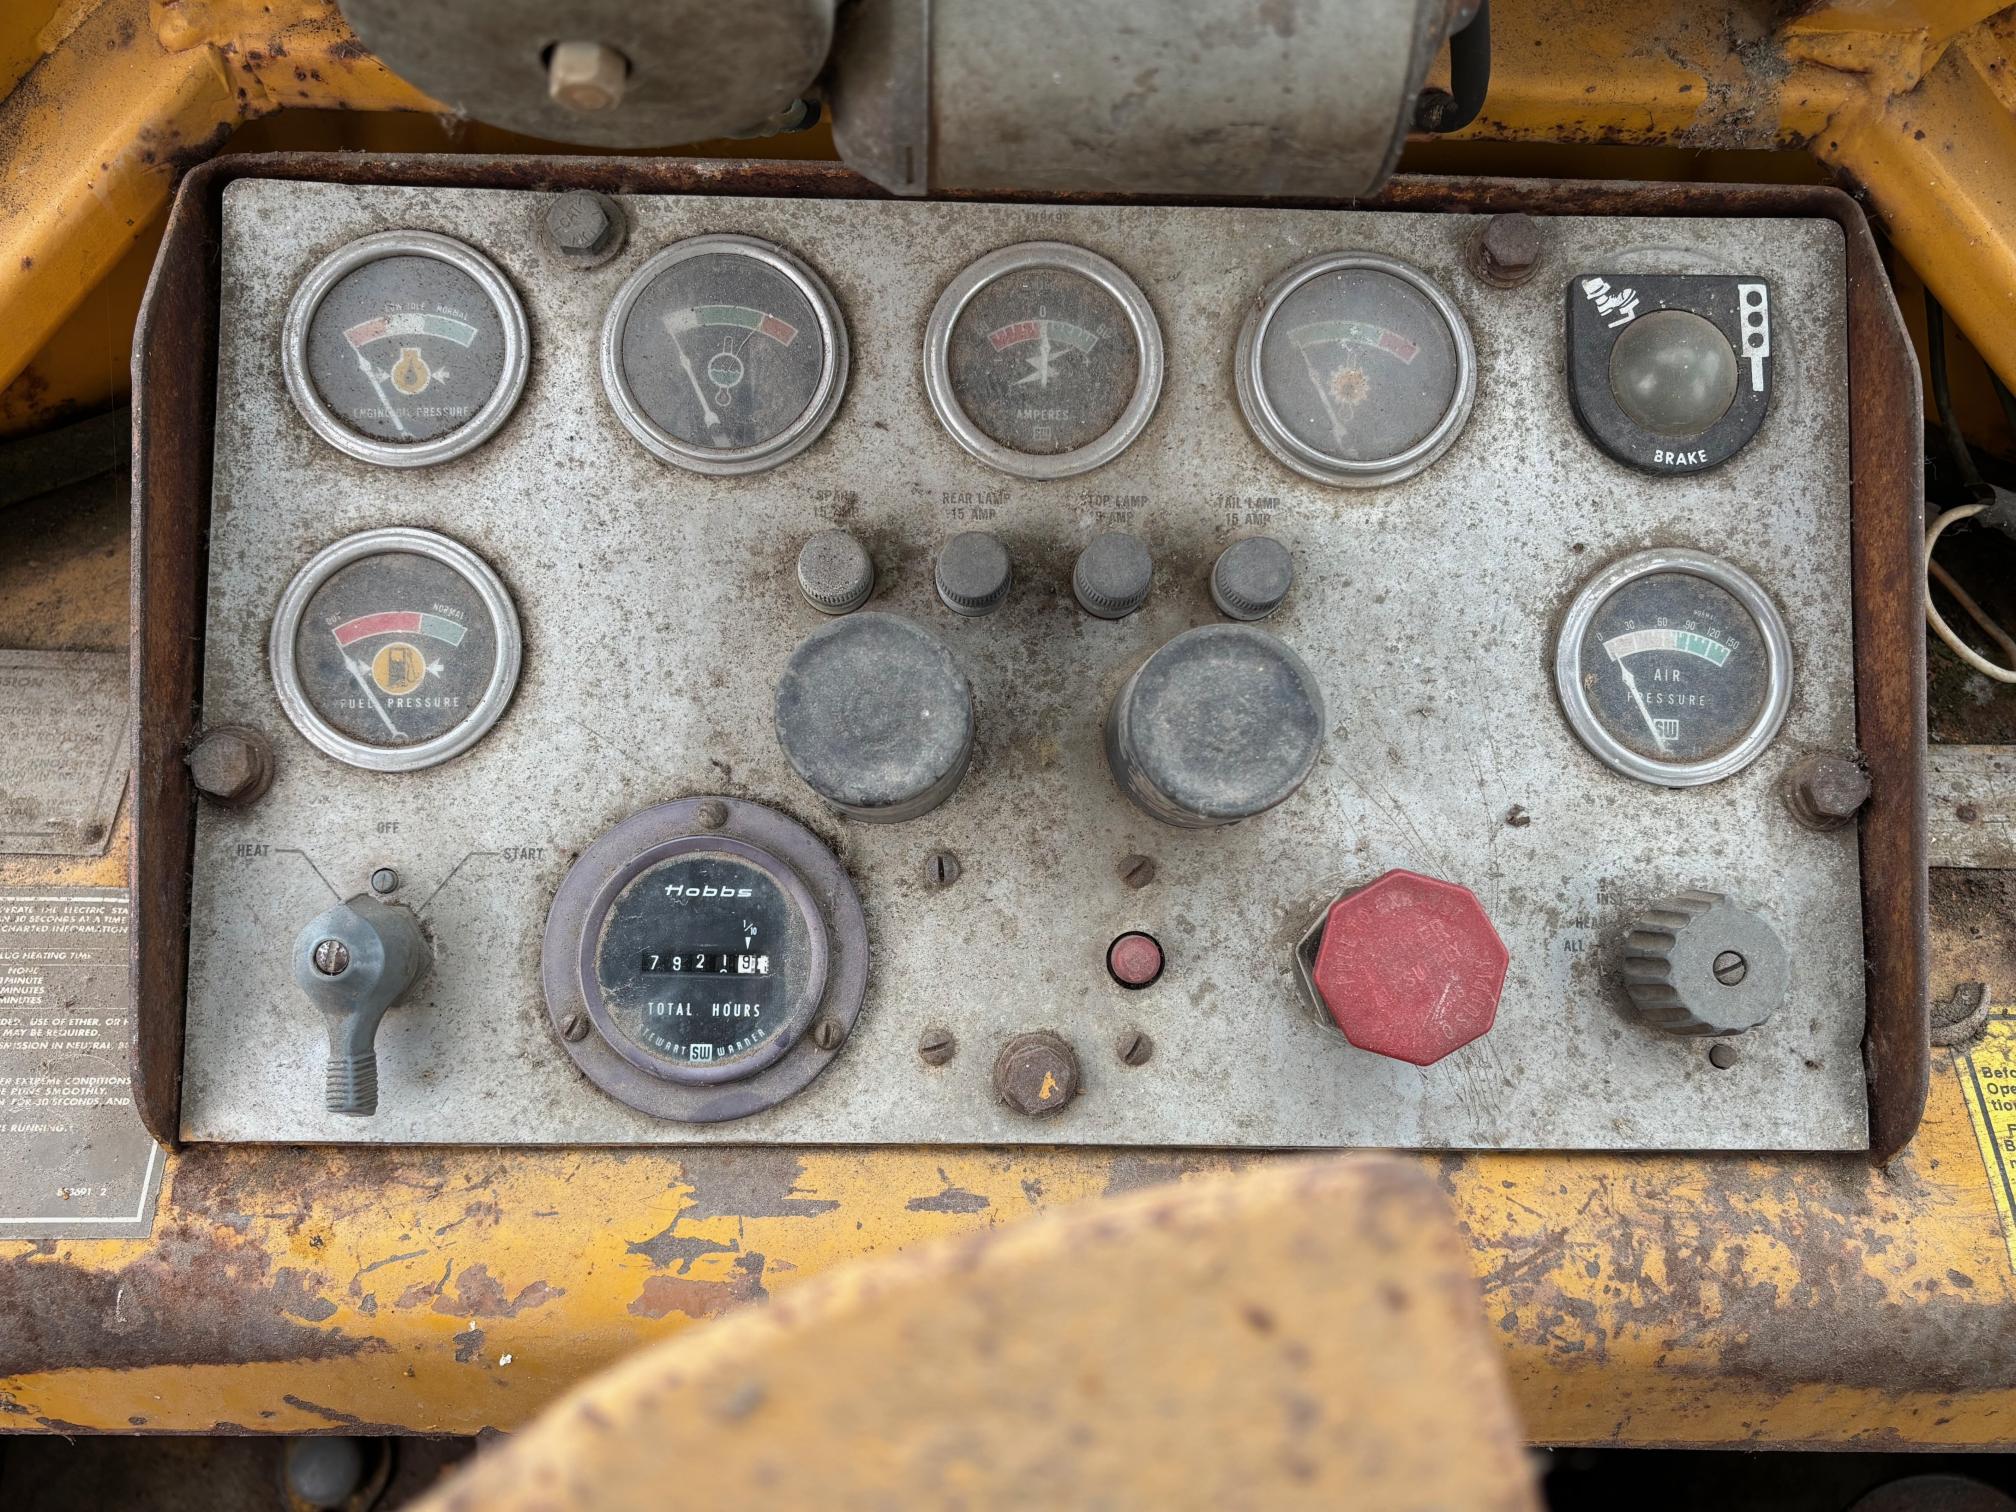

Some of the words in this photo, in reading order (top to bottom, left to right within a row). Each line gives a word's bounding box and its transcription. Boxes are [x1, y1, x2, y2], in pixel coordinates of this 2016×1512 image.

[416, 406, 470, 417] PRESSURE
[1016, 409, 1069, 420] AMPERES
[1653, 449, 1708, 466] BRAKE
[942, 492, 973, 505] REAR
[978, 492, 1011, 505] LAMP
[1115, 495, 1149, 508] LAMP
[1215, 496, 1242, 509] TAIL
[971, 508, 997, 520] AMP
[1244, 513, 1272, 526] AMP
[433, 603, 465, 620] NORMAL
[1624, 619, 1635, 631] 30
[1657, 616, 1668, 628] 60
[1685, 619, 1696, 631] 90
[1706, 626, 1721, 639] 120
[1725, 635, 1740, 650] 150
[1654, 668, 1681, 682] AIR
[340, 698, 373, 710] FUEL
[387, 697, 460, 709] PRESSURE
[376, 821, 399, 834] OFF
[236, 844, 270, 857] HEAT
[503, 847, 545, 861] START
[664, 884, 753, 898] Hobbs
[29, 915, 76, 923] SECONDS
[1, 925, 49, 933] CHARTED
[52, 925, 129, 934] INFORMATION
[22, 952, 67, 960] HEATING
[0, 987, 45, 995] MINUTES
[648, 1002, 693, 1017] TOTAL
[712, 1002, 761, 1017] HOURS
[30, 1018, 49, 1026] USE
[51, 1018, 66, 1026] OF
[105, 1018, 121, 1026] OR
[2, 1029, 27, 1037] MAY
[30, 1029, 43, 1037] BE
[46, 1029, 101, 1038] REQUIRED.
[51, 1042, 64, 1050] IN
[690, 1044, 712, 1060] SW
[716, 1028, 766, 1057] WARNER
[65, 1077, 132, 1086] CONDITIONS
[45, 1087, 108, 1096] SMOOTHLY.
[105, 1098, 131, 1106] AND
[100, 1187, 107, 1196] 2
